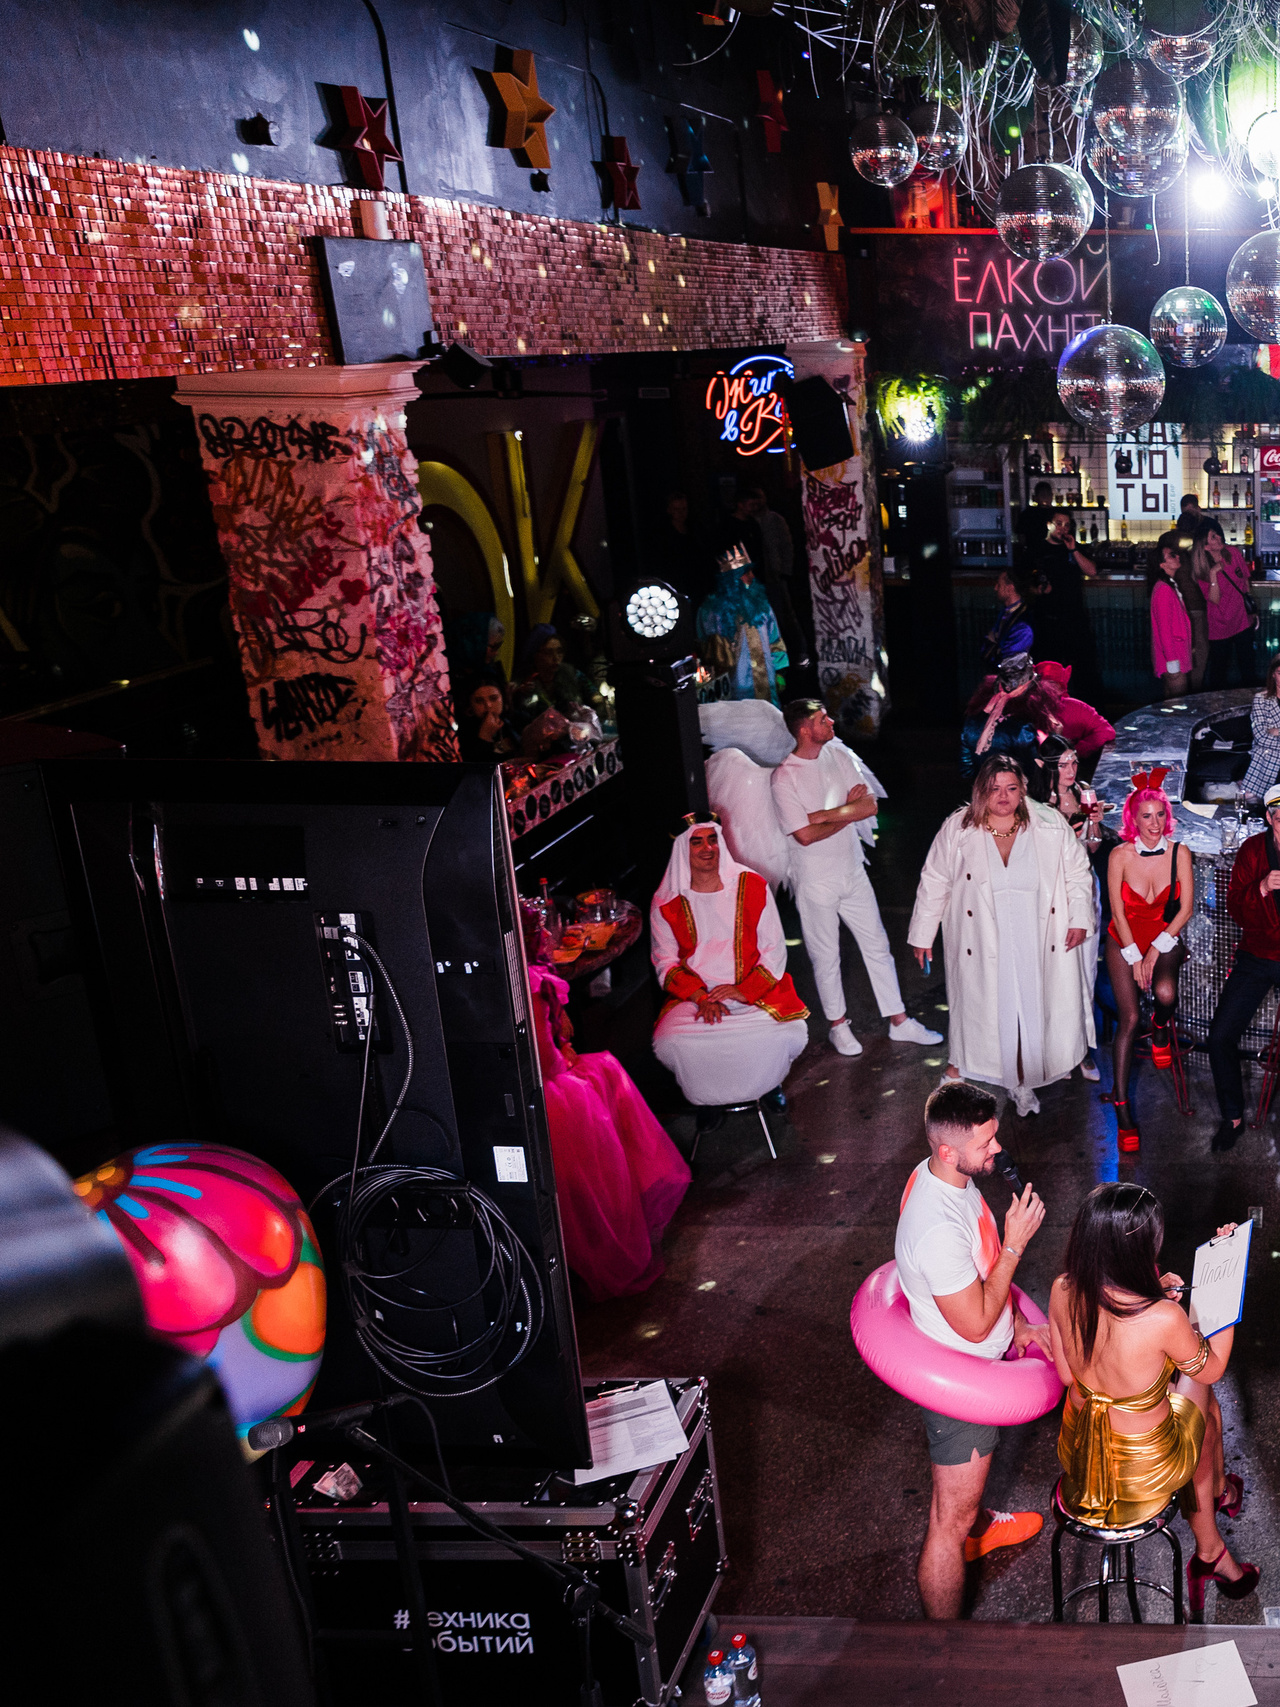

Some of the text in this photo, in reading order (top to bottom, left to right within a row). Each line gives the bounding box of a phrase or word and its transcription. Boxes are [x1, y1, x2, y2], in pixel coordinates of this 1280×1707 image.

[953, 243, 1111, 305] ЁЛКОЙ
[1116, 483, 1168, 513] ТЫ
[393, 1609, 531, 1630] #ехника
[402, 1630, 534, 1654] бытий
